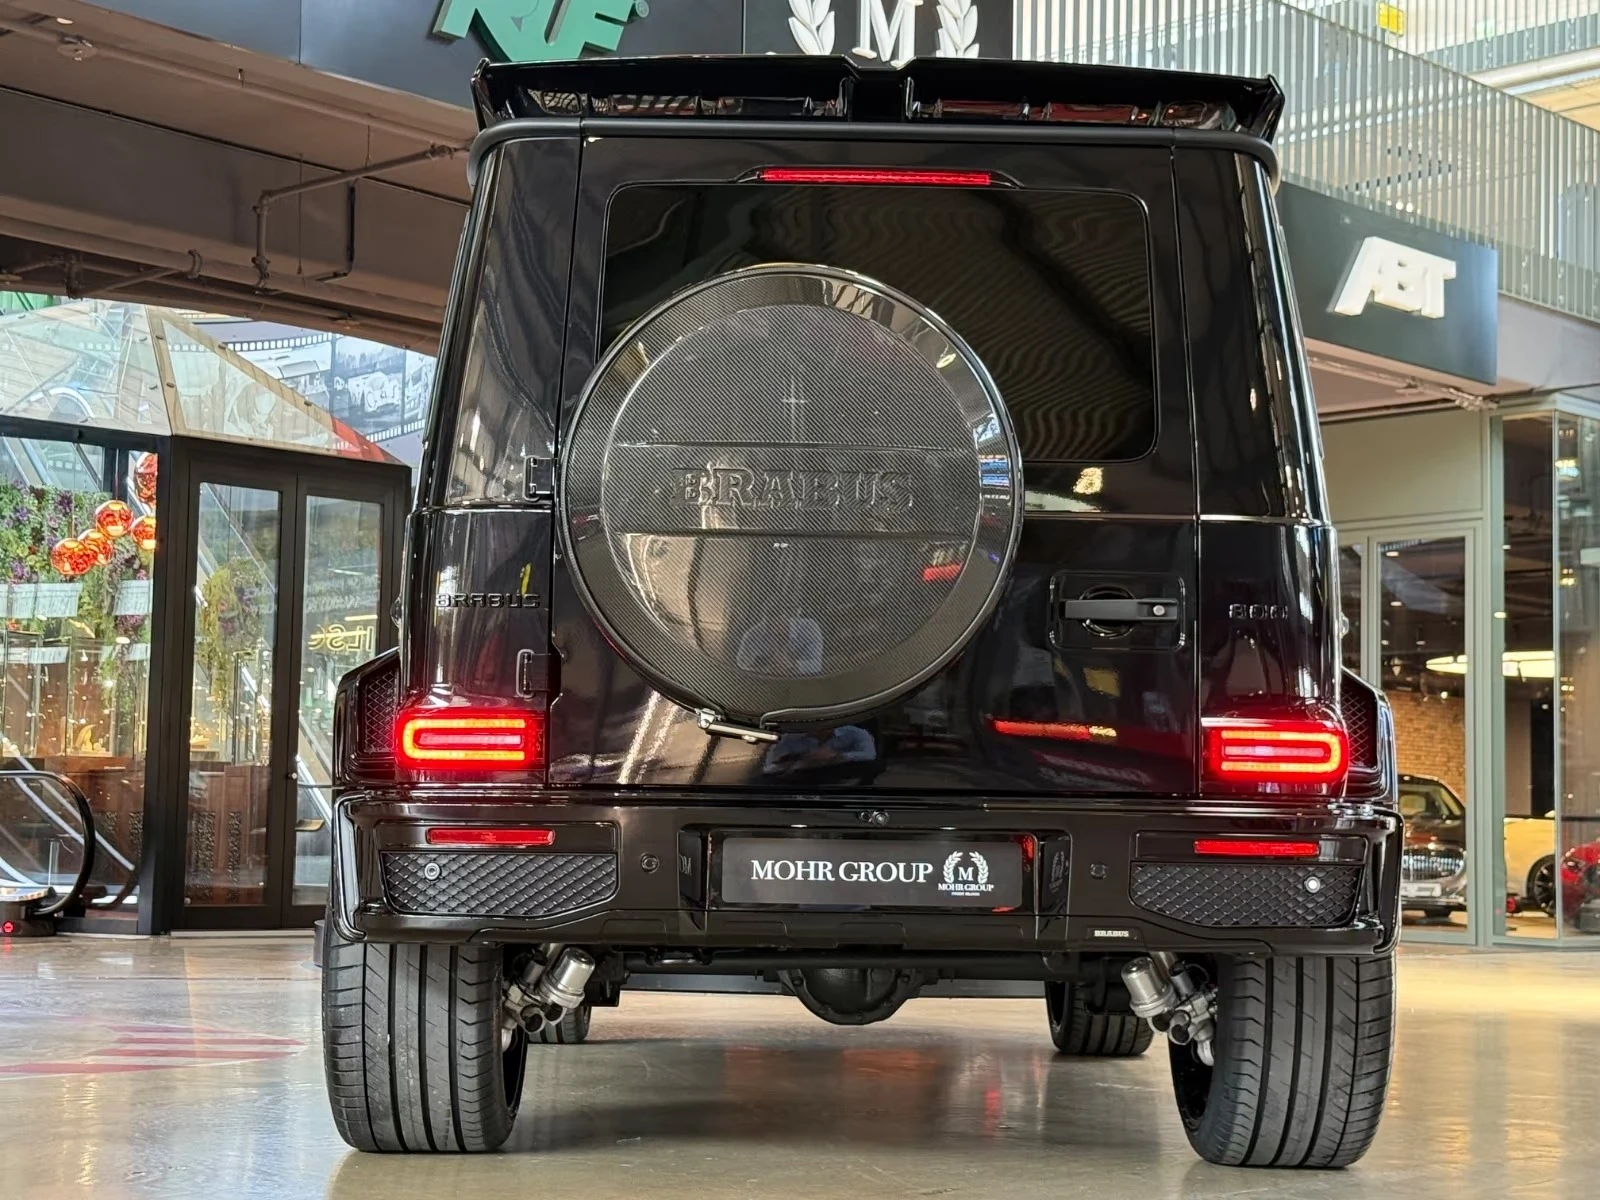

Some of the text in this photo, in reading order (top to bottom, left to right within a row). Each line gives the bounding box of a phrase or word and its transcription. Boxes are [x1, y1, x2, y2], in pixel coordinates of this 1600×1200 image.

[851, 0, 923, 70] M
[1332, 236, 1457, 319] ABT
[670, 467, 914, 511] BRABUS
[434, 592, 541, 609] BRABUS
[750, 859, 934, 883] MOHR GROUP
[957, 866, 974, 881] M
[937, 883, 995, 892] MOHR GROUP
[1093, 930, 1130, 938] BRABUS
